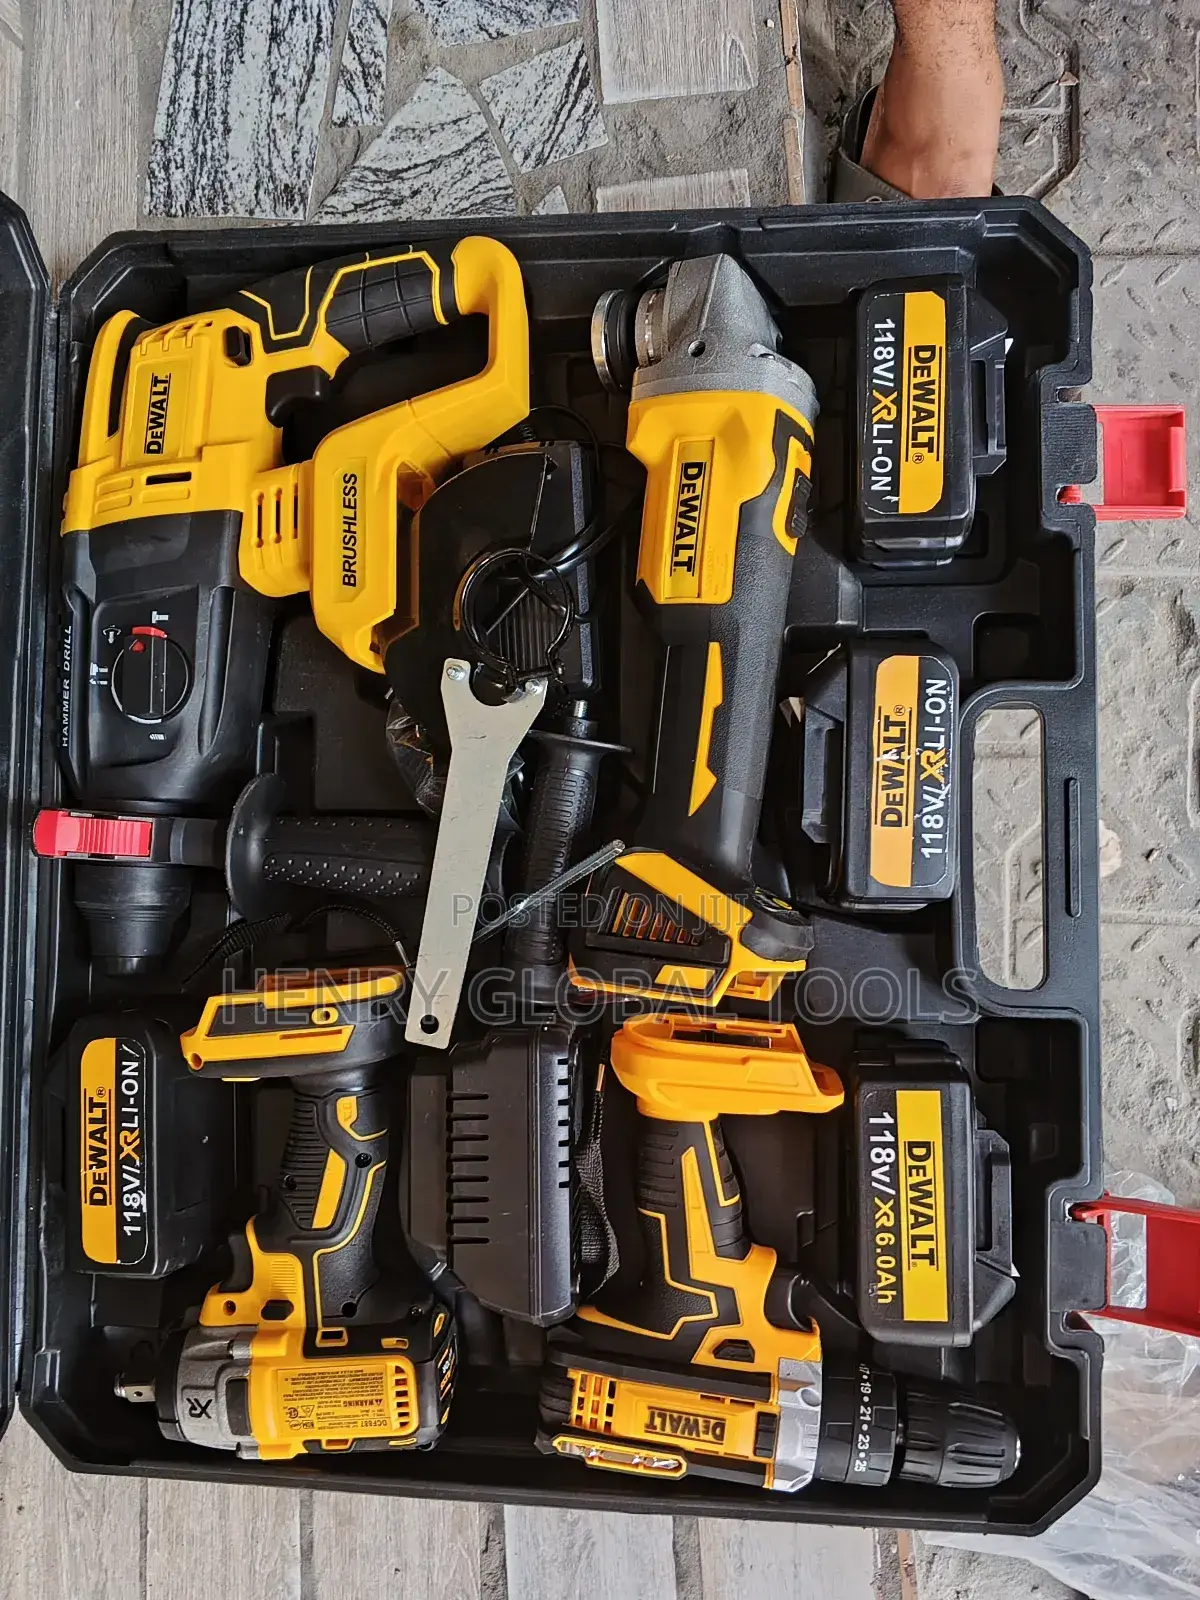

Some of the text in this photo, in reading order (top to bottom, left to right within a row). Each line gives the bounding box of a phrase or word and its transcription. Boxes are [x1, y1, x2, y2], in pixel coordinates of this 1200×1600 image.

[342, 473, 358, 587] BRUSHLESS
[62, 625, 72, 747] HAMMER DRILL
[860, 1381, 872, 1394] 19
[186, 1397, 213, 1419] XR
[860, 1405, 872, 1421] 21
[644, 1411, 726, 1441] DEWALT
[857, 1433, 870, 1450] 23
[854, 1459, 867, 1472] 25
